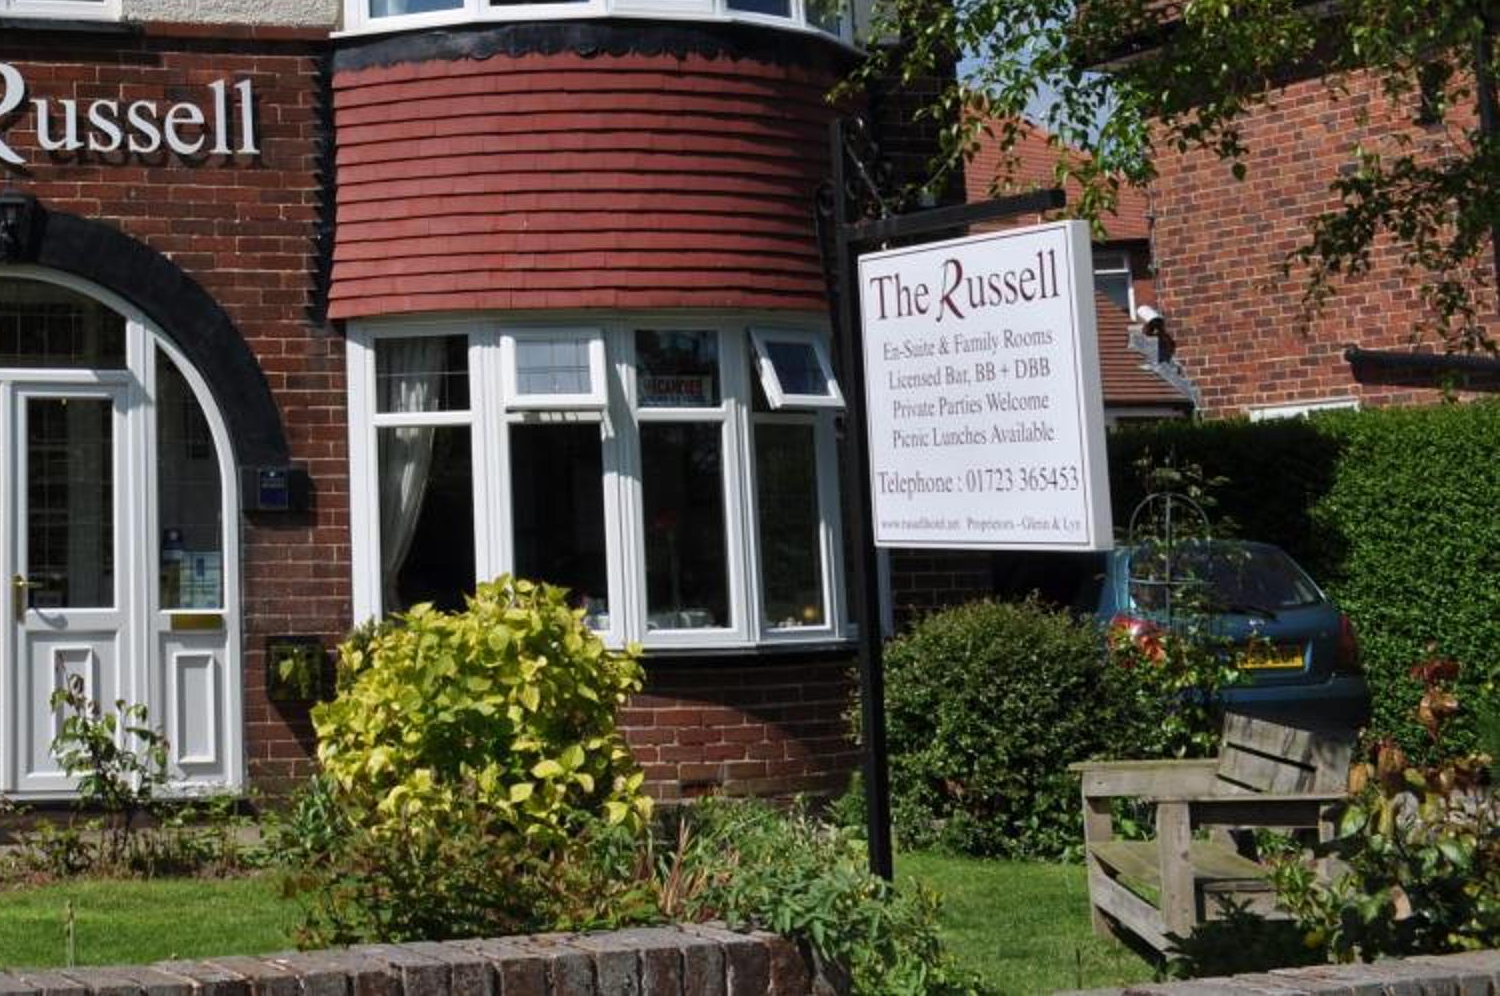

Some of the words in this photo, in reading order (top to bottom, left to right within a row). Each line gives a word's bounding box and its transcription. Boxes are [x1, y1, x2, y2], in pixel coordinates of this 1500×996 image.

[870, 273, 929, 320] The
[935, 249, 1060, 323] Russell
[883, 339, 935, 361] En-Suite
[938, 335, 949, 355] &
[954, 332, 999, 355] Family
[1003, 329, 1053, 349] Rooms
[889, 366, 941, 390] Licensed
[945, 365, 971, 387] Bar,
[975, 361, 997, 383] BB
[1015, 357, 1051, 379] DBB
[892, 399, 935, 420] Private
[939, 395, 983, 417] Parties
[986, 392, 1049, 413] Welcome
[892, 428, 930, 449] Picnic
[932, 425, 987, 447] Lunches
[991, 421, 1055, 444] Available
[877, 469, 953, 500] Telephone
[965, 468, 1013, 493] 01723
[1019, 465, 1079, 492] 365453
